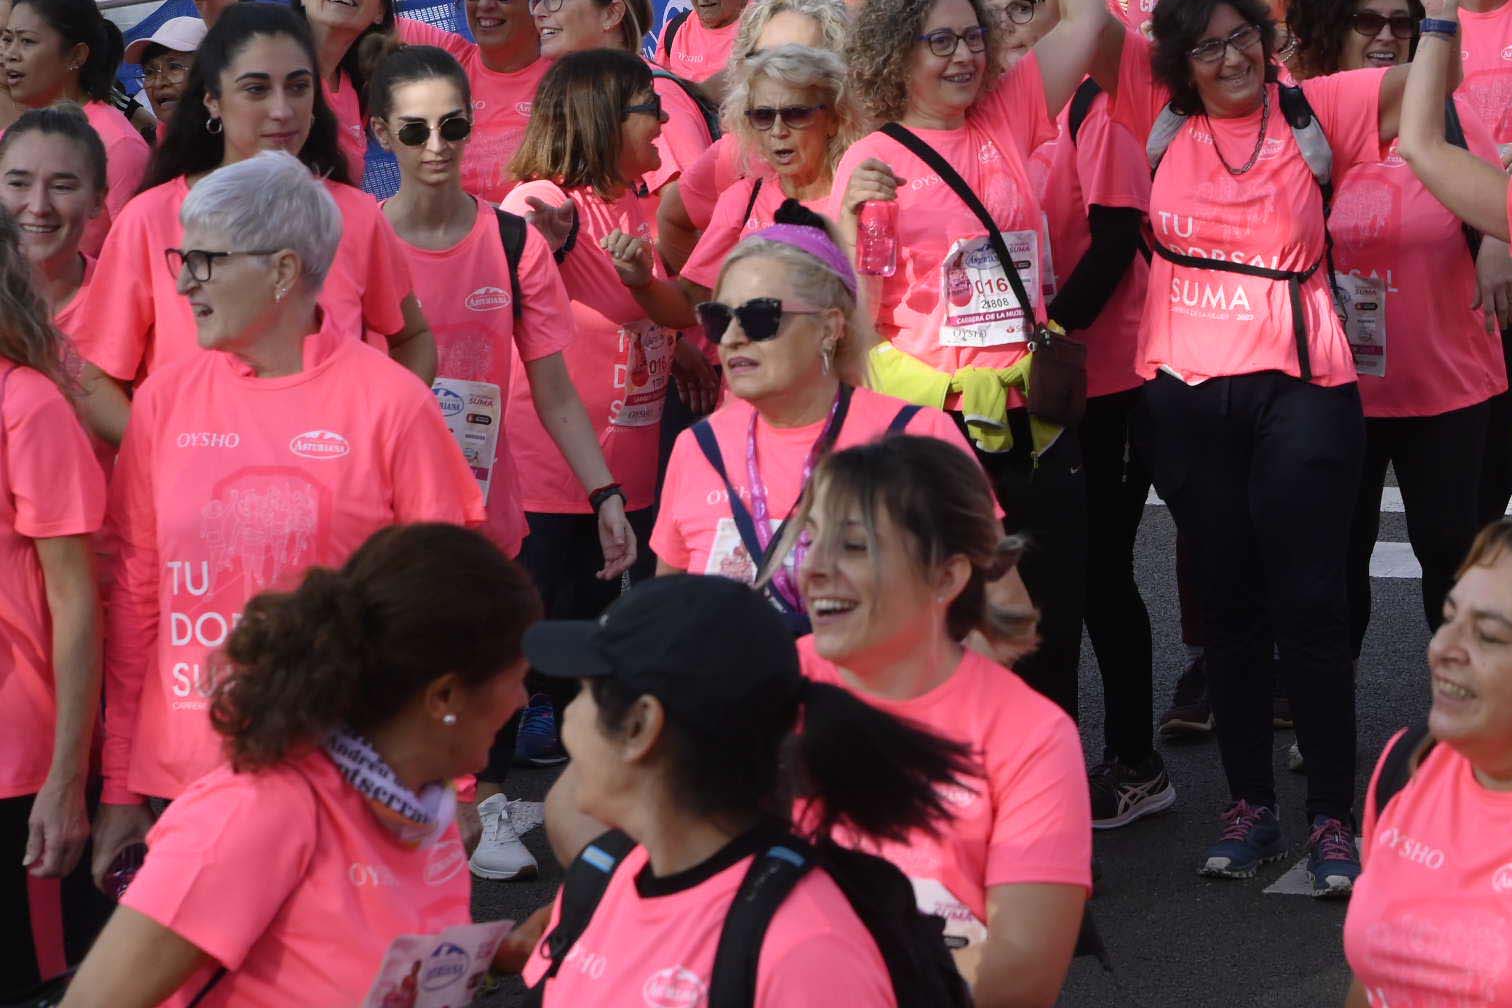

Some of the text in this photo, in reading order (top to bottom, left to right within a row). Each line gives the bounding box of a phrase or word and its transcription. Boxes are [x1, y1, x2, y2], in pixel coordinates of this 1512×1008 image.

[1158, 210, 1193, 238] TU
[975, 277, 1009, 294] 016
[1170, 277, 1252, 311] SUMA
[957, 309, 1025, 324] CARRERA DE LA MUJE
[176, 432, 240, 449] OYSHO
[293, 439, 347, 454] ASTURIANA
[166, 560, 209, 596] TU
[170, 611, 242, 647] DO
